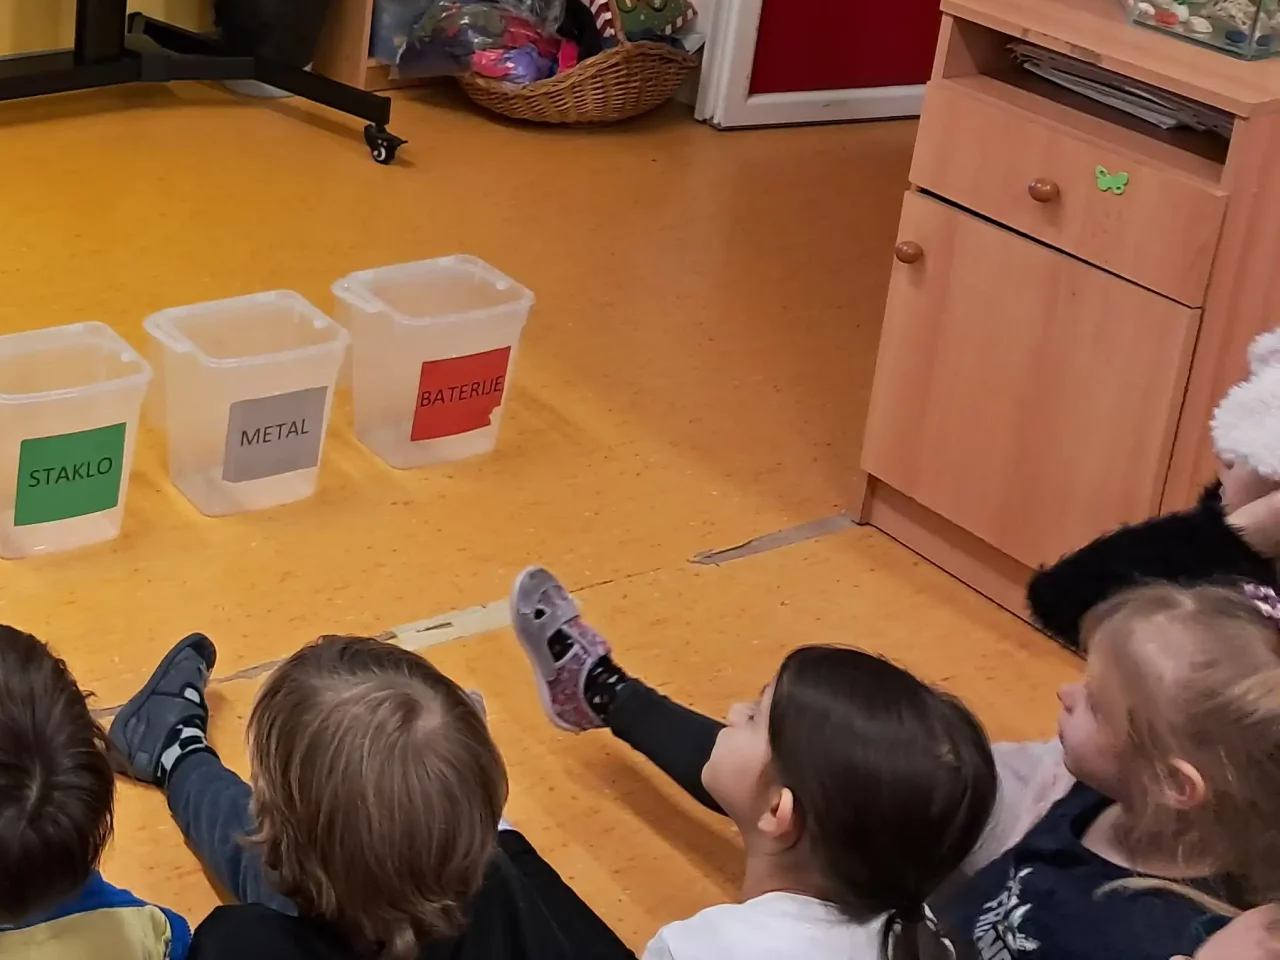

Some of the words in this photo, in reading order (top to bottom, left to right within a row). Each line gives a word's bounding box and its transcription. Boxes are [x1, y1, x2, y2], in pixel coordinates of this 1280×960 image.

[419, 373, 504, 408] BATERIJE
[240, 417, 310, 448] METAL
[28, 456, 113, 488] STAKLO
